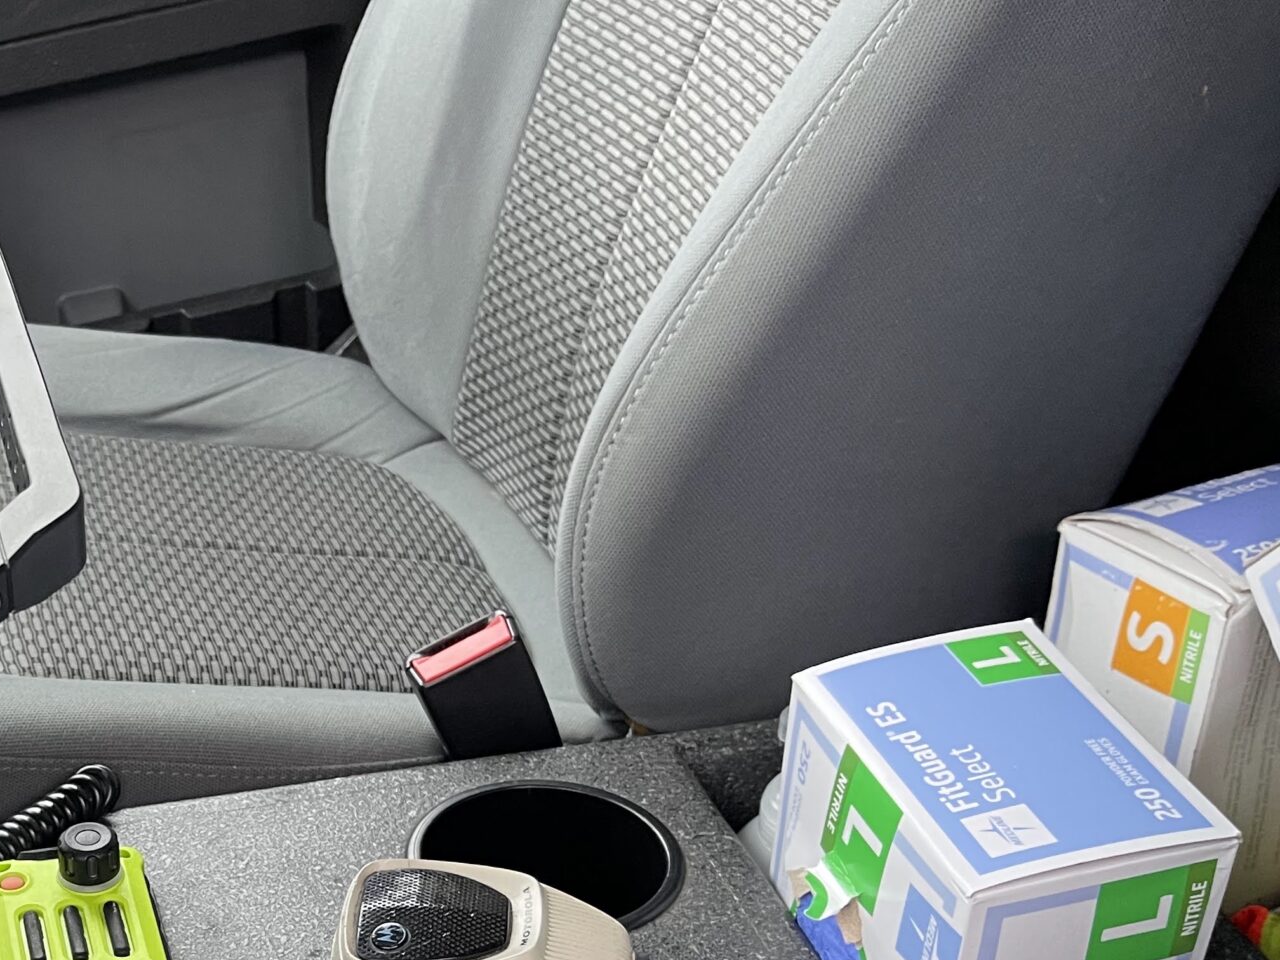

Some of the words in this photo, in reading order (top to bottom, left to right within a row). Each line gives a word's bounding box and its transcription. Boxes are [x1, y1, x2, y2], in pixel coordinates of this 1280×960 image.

[971, 645, 1022, 669] L
[1016, 638, 1051, 668] NITRILE
[1126, 610, 1175, 666] S
[1179, 629, 1202, 684] NITRILE
[865, 701, 907, 729] ES
[797, 740, 811, 785] 250
[949, 743, 1017, 804] Select
[827, 772, 848, 835] NITRILE
[1134, 788, 1183, 820] 250
[841, 804, 884, 857] L
[520, 886, 531, 946] MOTOROLA
[1100, 894, 1174, 943] L
[1180, 881, 1208, 937] NITRILE
